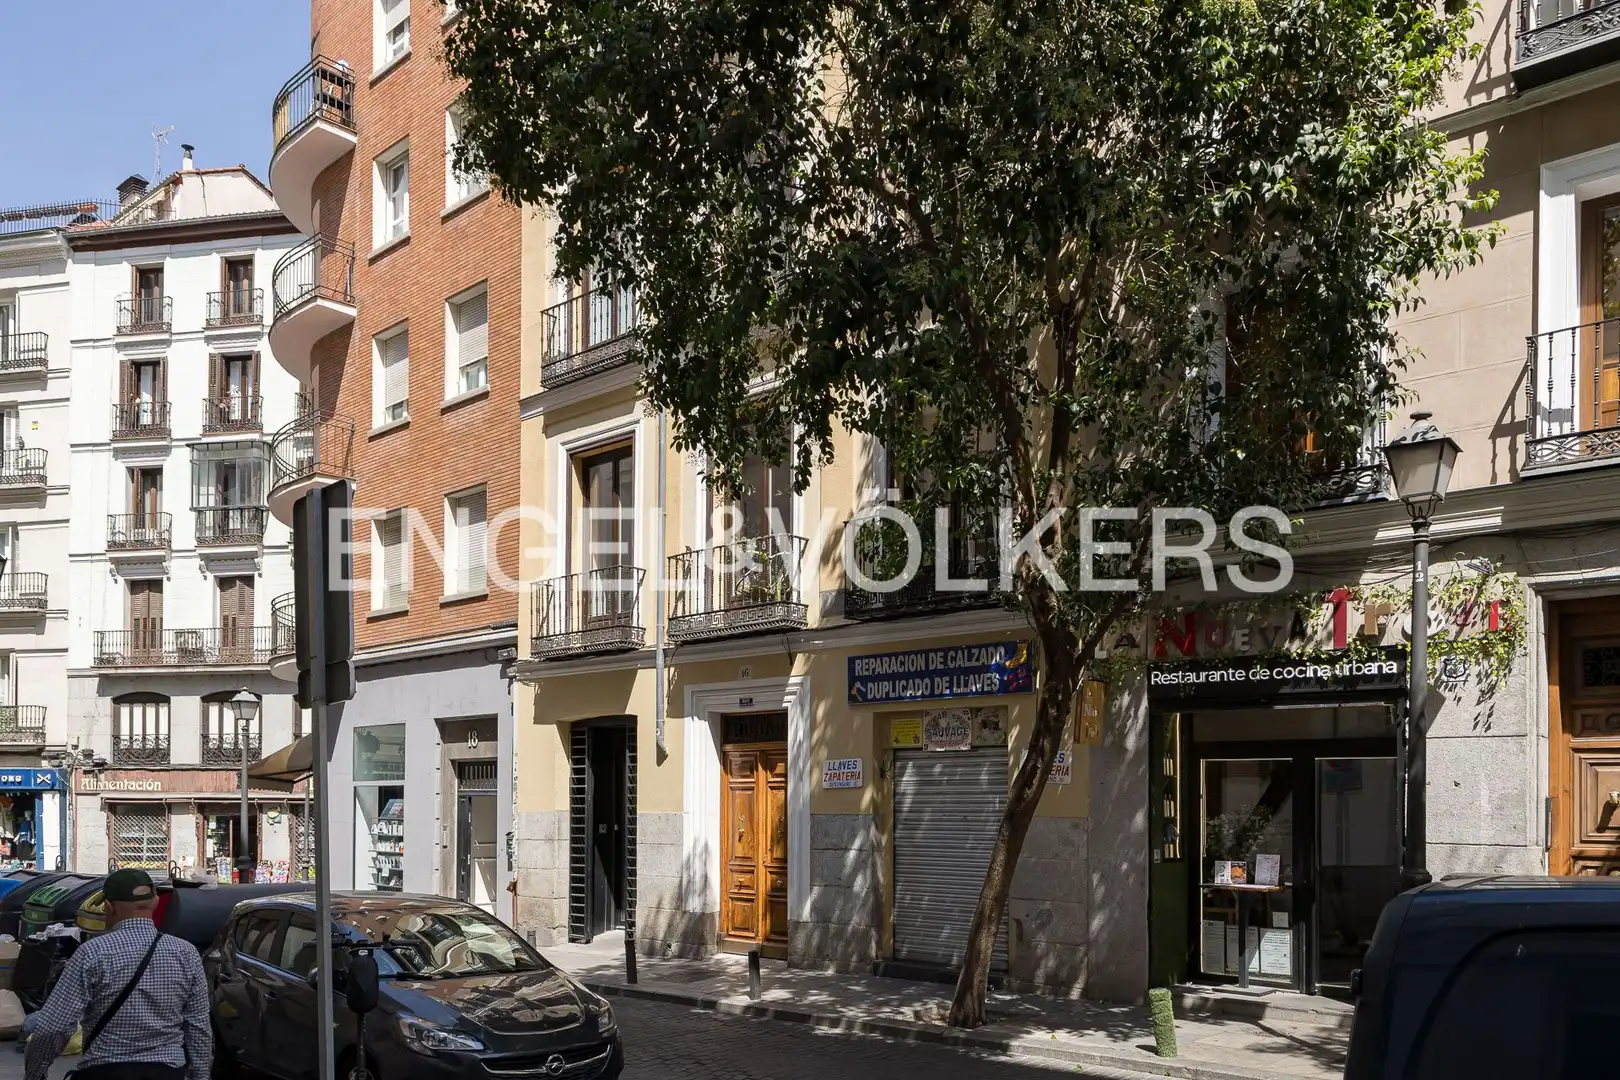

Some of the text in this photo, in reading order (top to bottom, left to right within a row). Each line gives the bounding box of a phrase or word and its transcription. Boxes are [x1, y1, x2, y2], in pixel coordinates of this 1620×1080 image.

[855, 646, 1005, 676] REPARACION DE CALZADO
[1151, 664, 1246, 685] Restaurante
[1249, 664, 1271, 681] de
[1273, 662, 1331, 679] cocina
[867, 673, 1000, 700] DUPLICADO DE LLAVES
[468, 730, 478, 747] 18
[828, 760, 858, 771] LLAVES
[823, 771, 861, 783] ZAPATERIA
